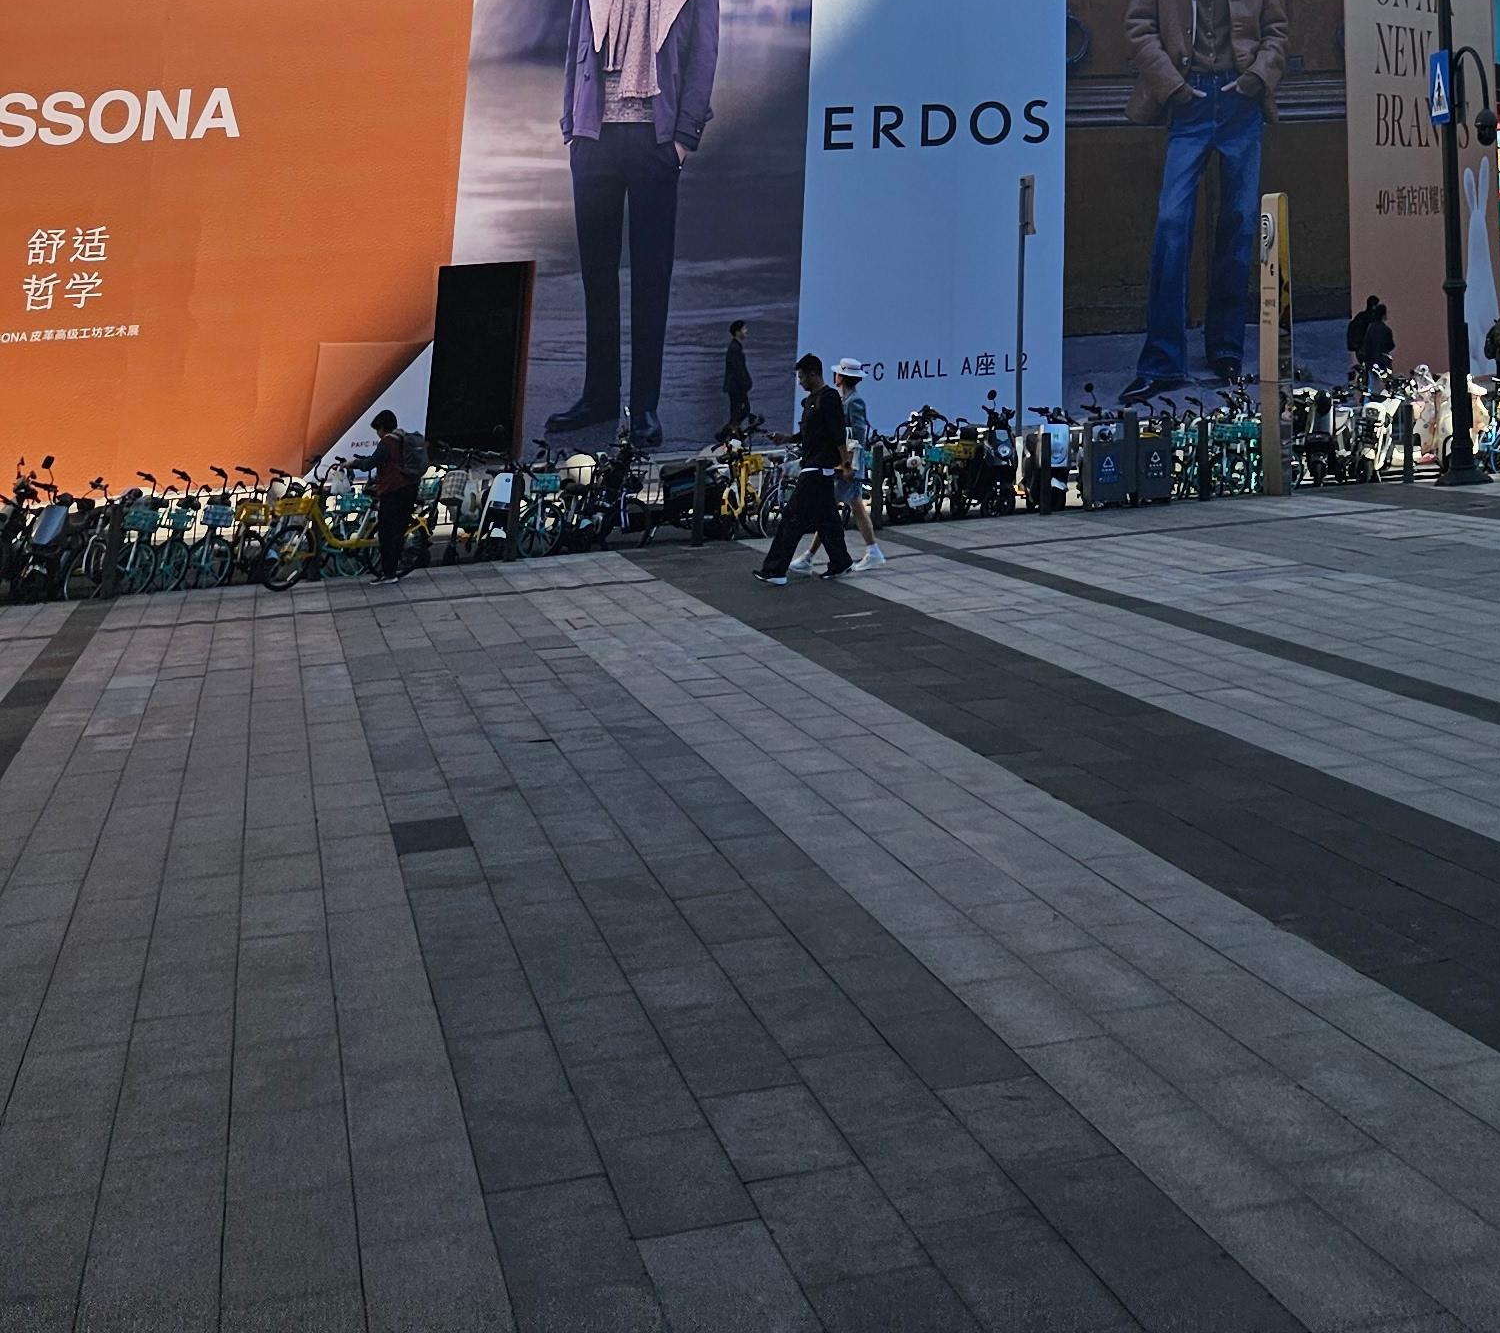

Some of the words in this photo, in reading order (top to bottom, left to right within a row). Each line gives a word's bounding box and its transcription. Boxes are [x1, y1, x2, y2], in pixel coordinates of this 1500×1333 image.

[1374, 22, 1432, 78] NEW
[0, 87, 241, 148] SSONA
[823, 99, 1051, 151] ERDOS
[1375, 92, 1470, 150] BRANS
[27, 225, 111, 266] 舒适
[22, 271, 103, 312] 哲学
[29, 324, 140, 343] 皮革高级工坊艺术展
[897, 358, 948, 380] MALL
[960, 352, 997, 377] A座
